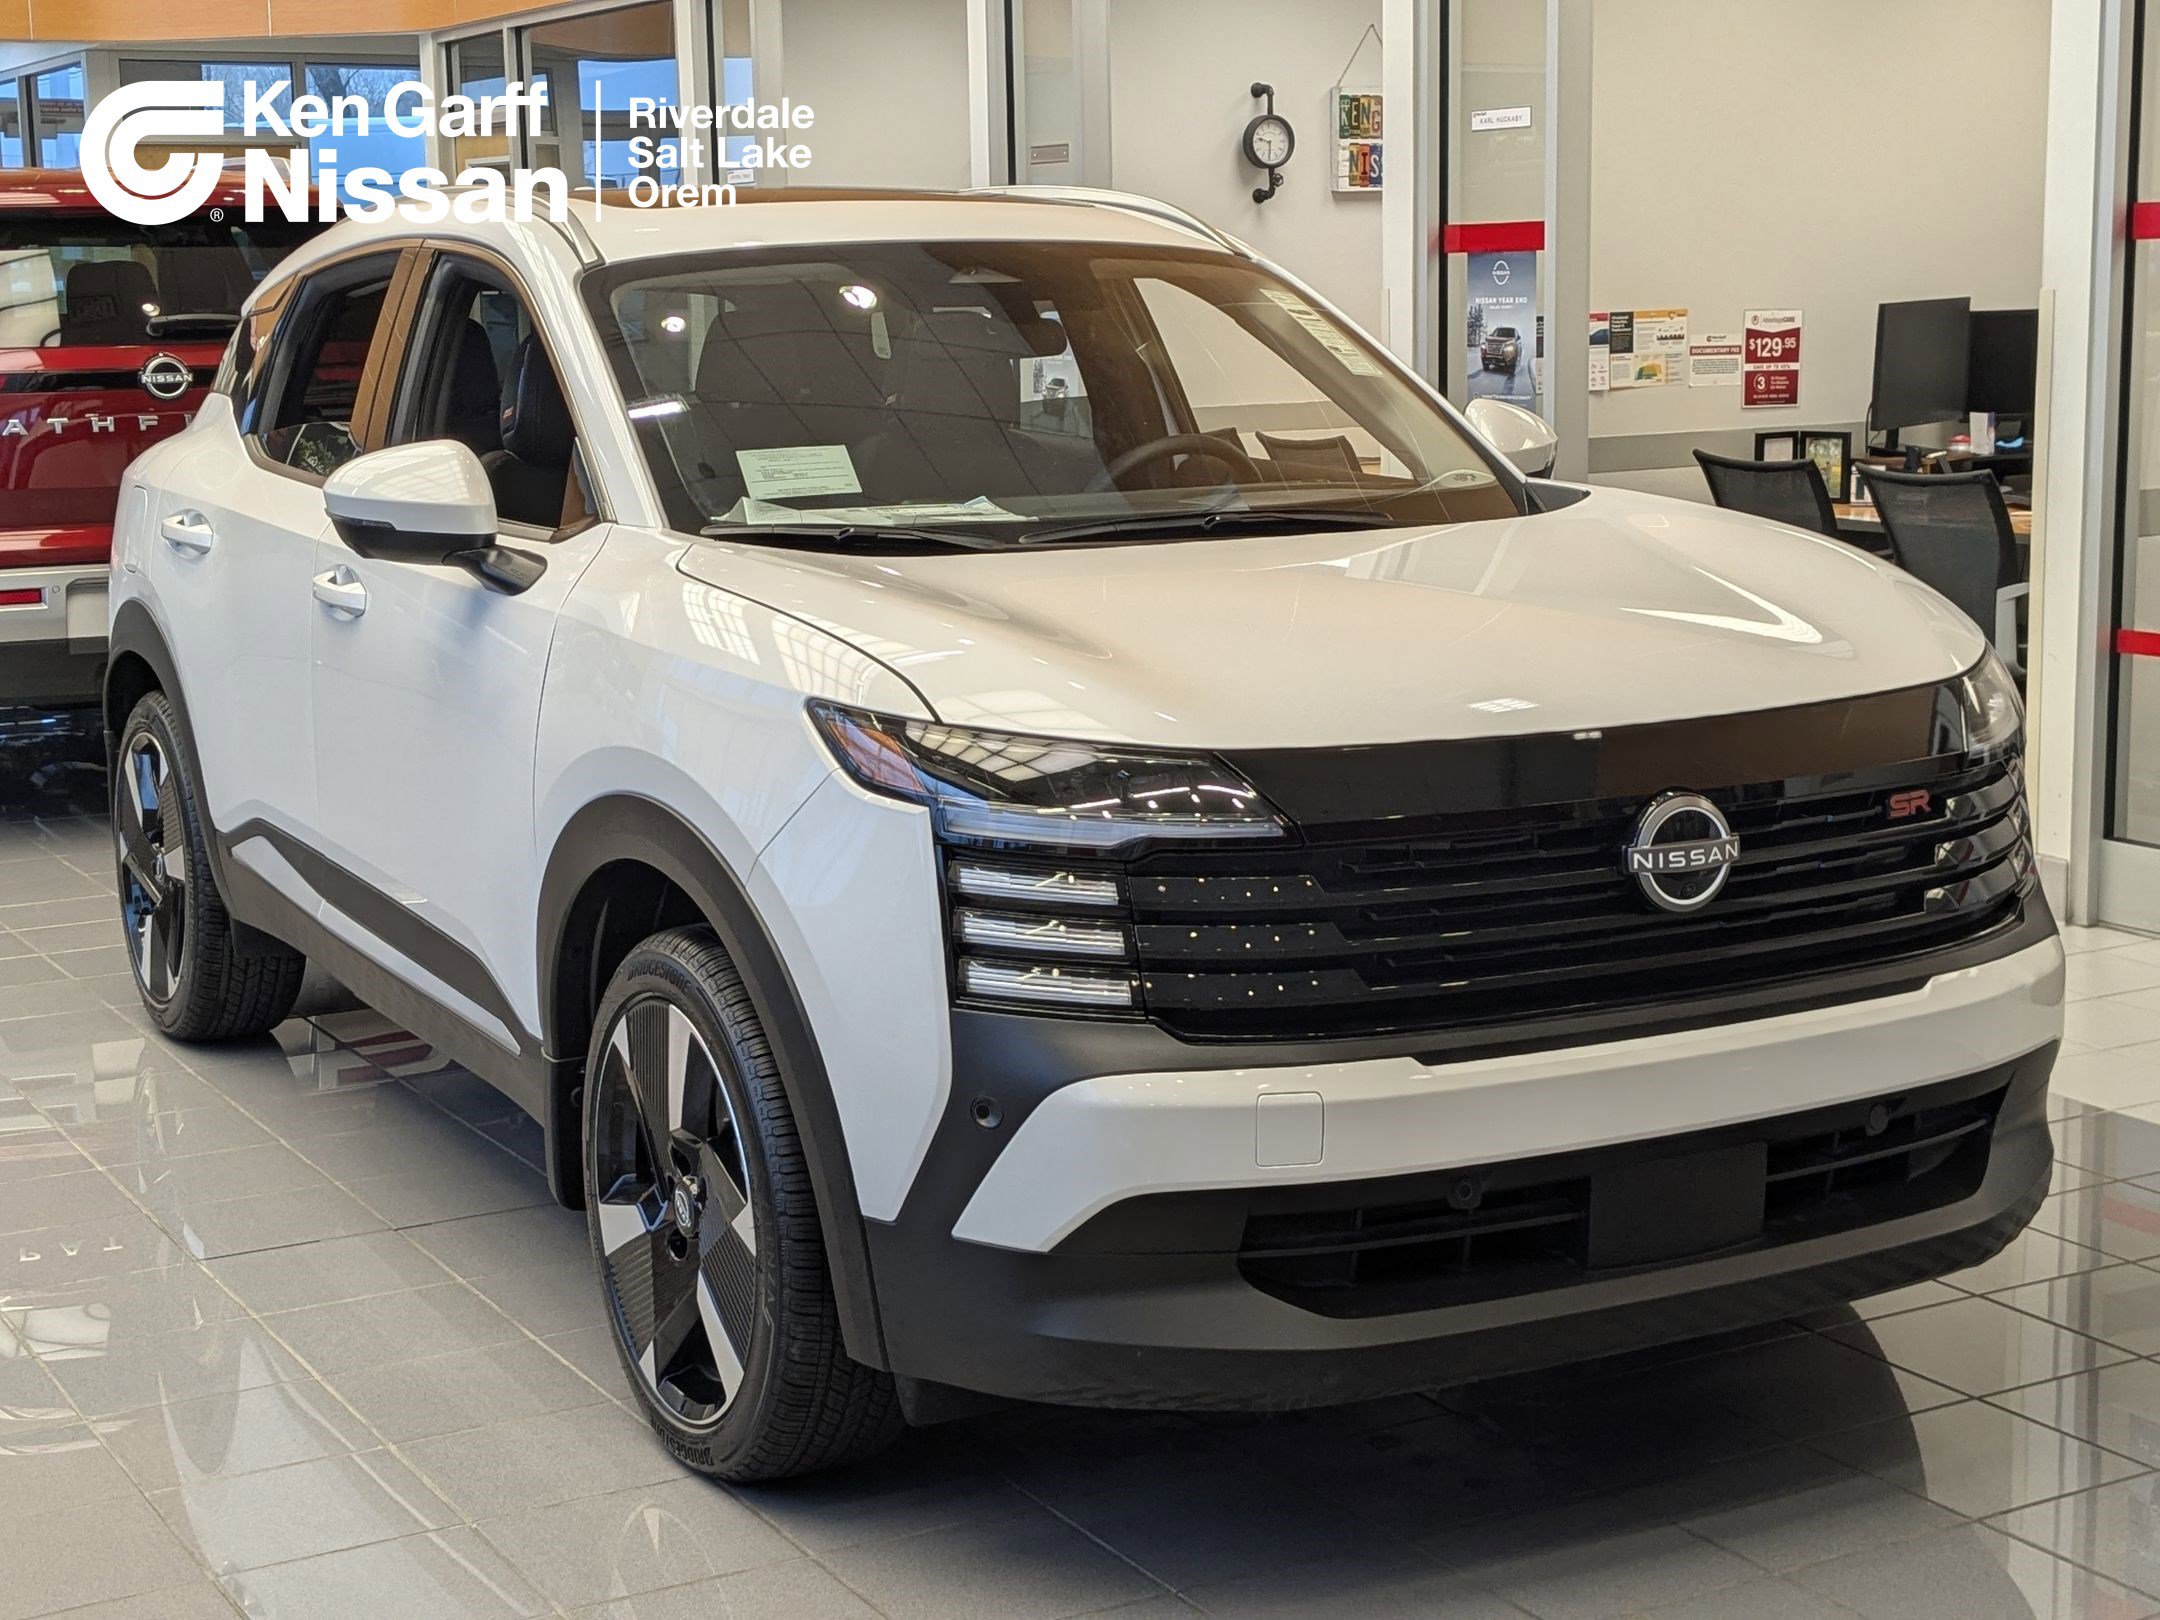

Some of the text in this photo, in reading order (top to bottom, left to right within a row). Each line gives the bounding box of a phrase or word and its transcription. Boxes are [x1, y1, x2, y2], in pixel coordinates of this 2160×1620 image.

[1515, 296, 1528, 304] END
[1749, 337, 1796, 357] $129.95
[141, 373, 193, 383] NISSAN
[1757, 376, 1766, 390] 3
[1890, 789, 1931, 817] SR
[1633, 841, 1739, 869] NISSAN
